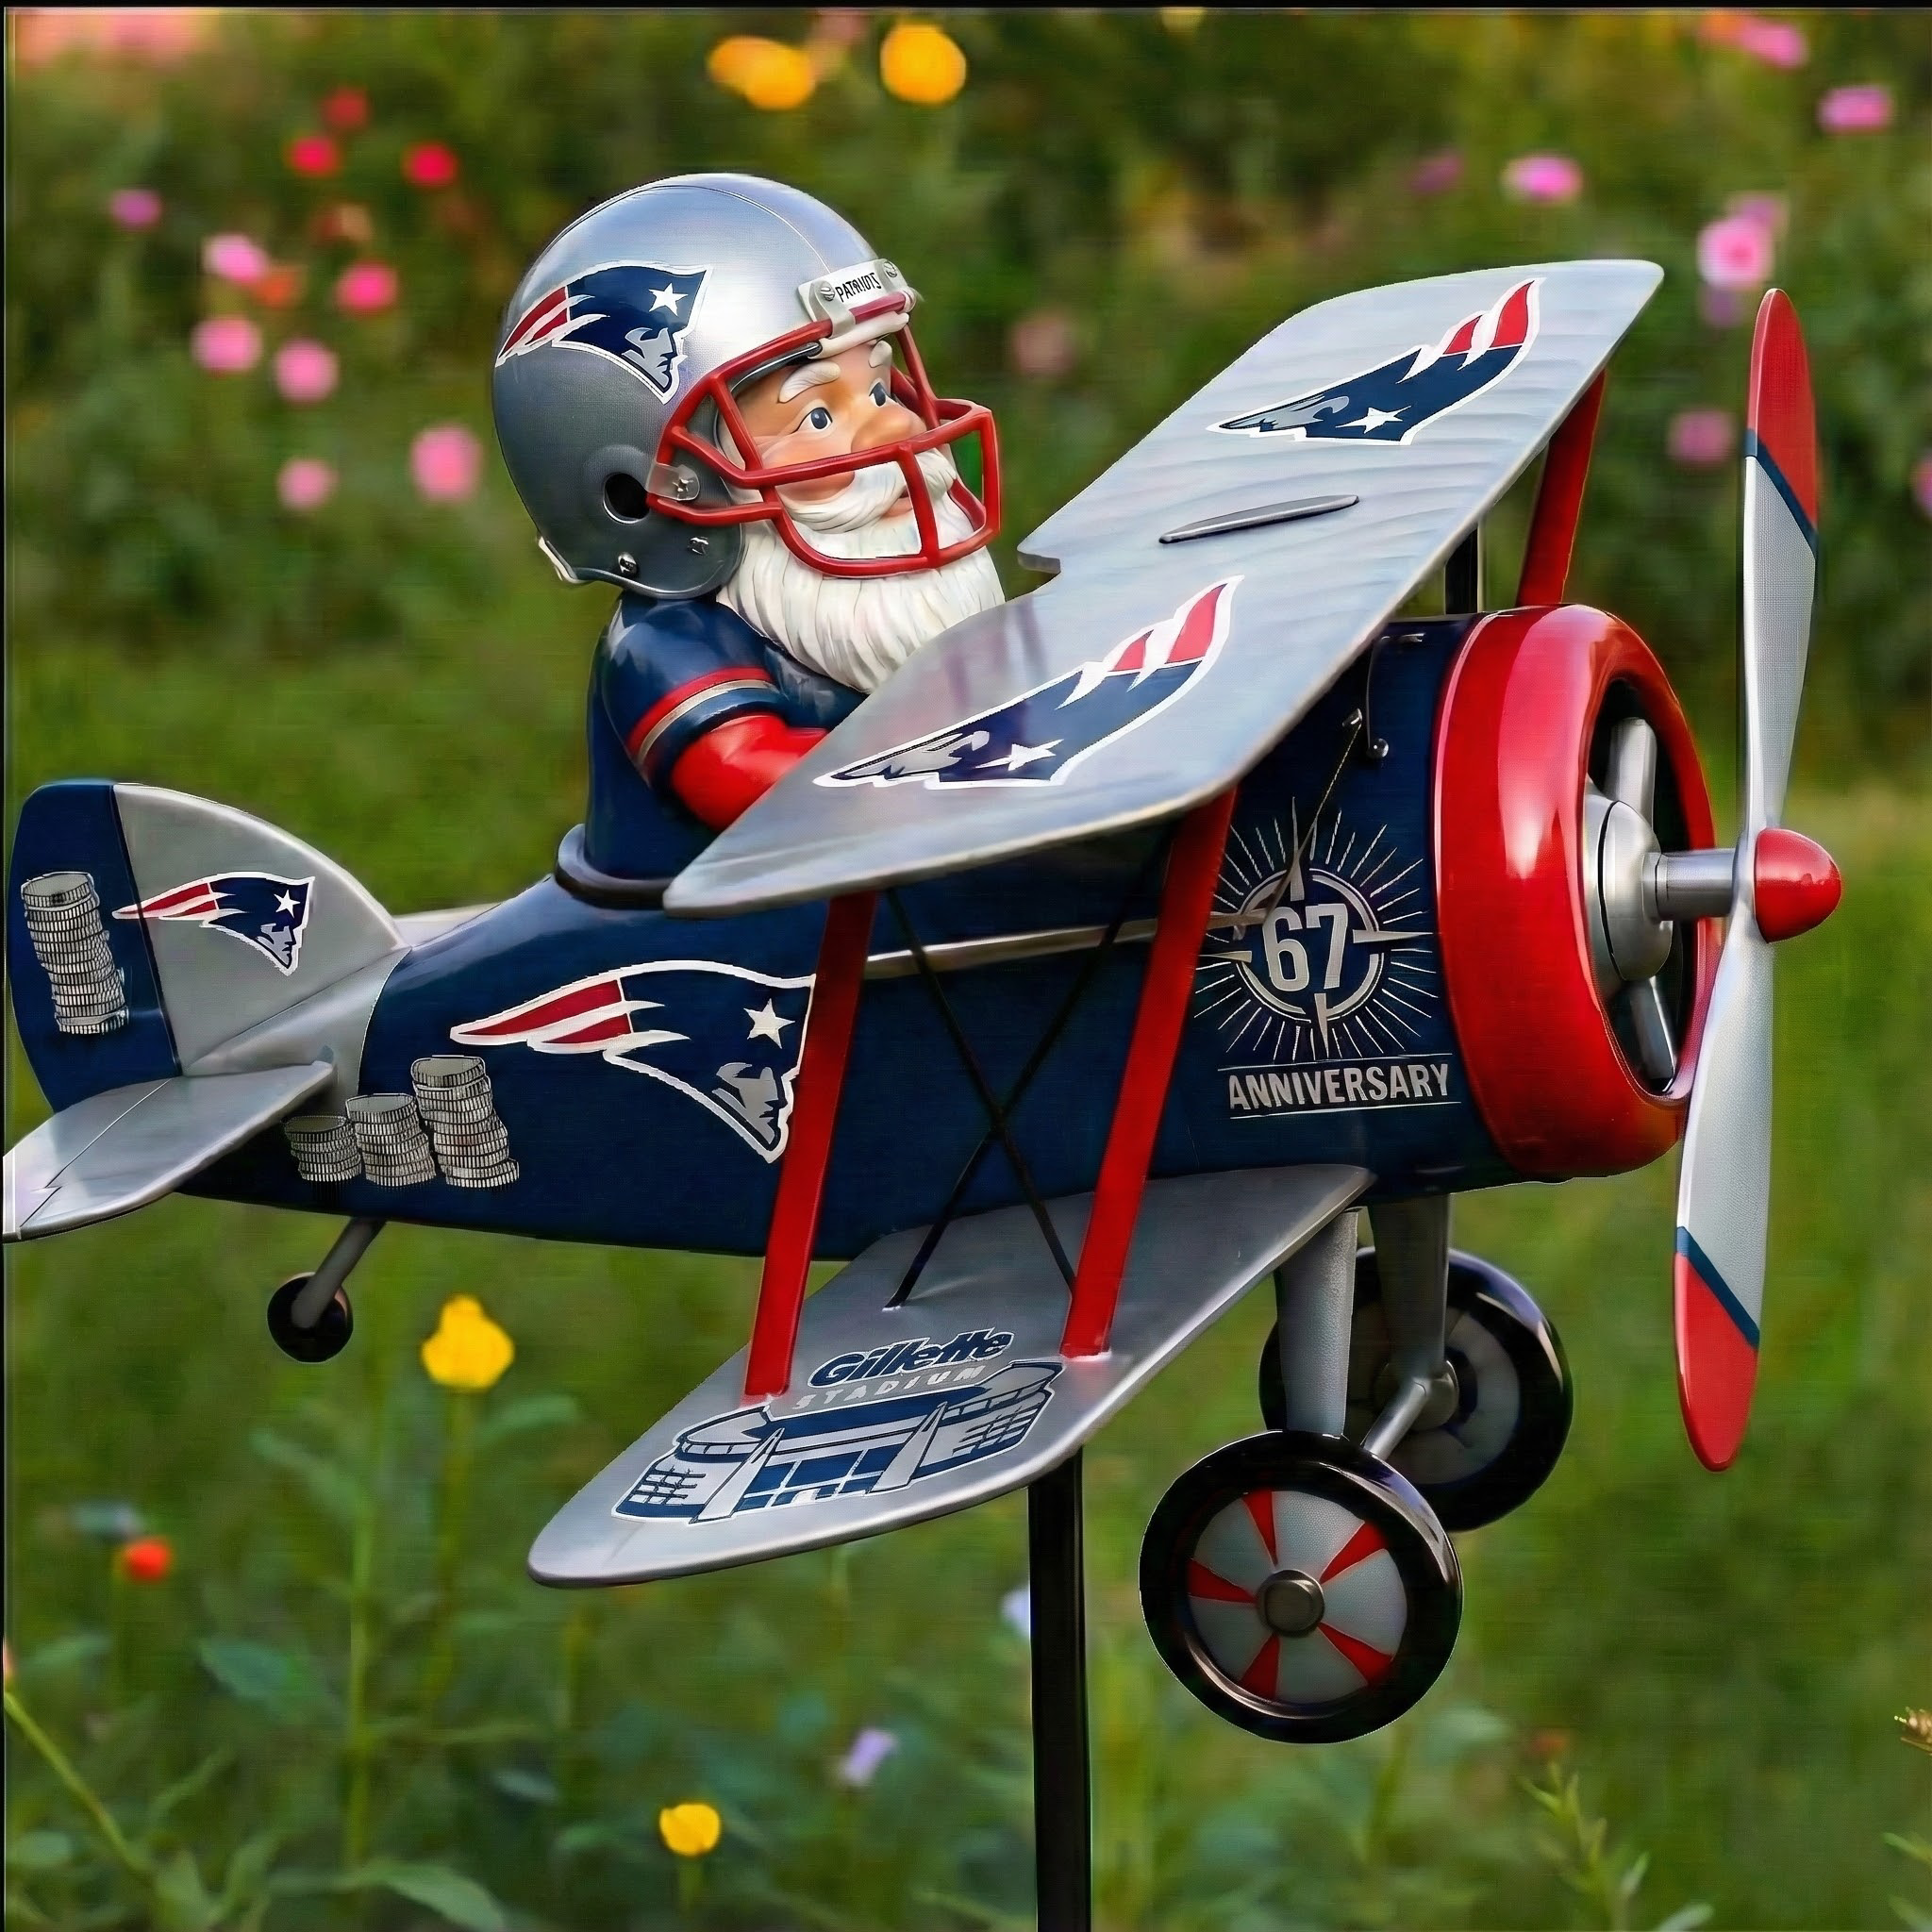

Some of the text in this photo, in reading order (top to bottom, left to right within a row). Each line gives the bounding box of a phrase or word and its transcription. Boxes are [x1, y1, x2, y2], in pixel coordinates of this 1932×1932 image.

[1262, 903, 1348, 991] 67
[1229, 1063, 1449, 1109] ANNIVERSARY
[808, 1328, 1013, 1387] Gillette
[792, 1366, 986, 1409] STADIUM
